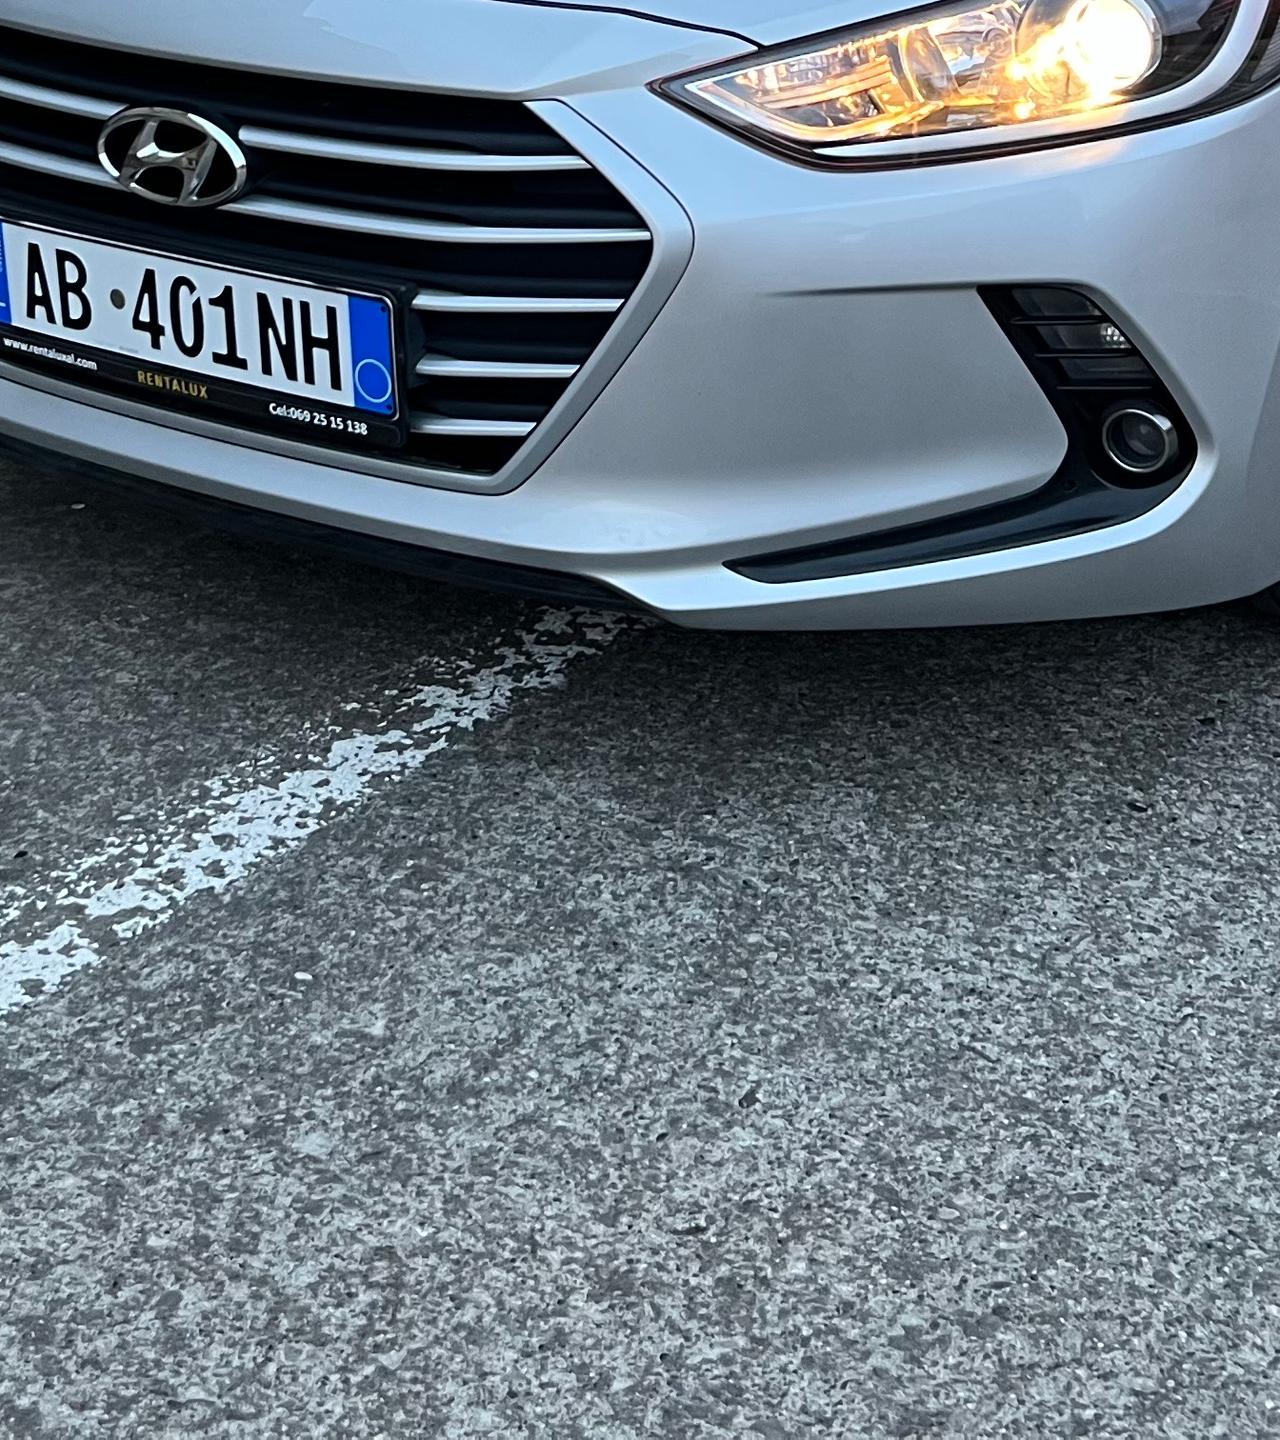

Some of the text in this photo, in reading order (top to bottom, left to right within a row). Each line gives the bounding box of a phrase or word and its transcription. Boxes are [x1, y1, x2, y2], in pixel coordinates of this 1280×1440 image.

[26, 242, 92, 331] AB
[137, 370, 208, 400] RENTALUX
[313, 412, 327, 426] 25
[330, 416, 344, 430] 15
[346, 420, 368, 435] 138
